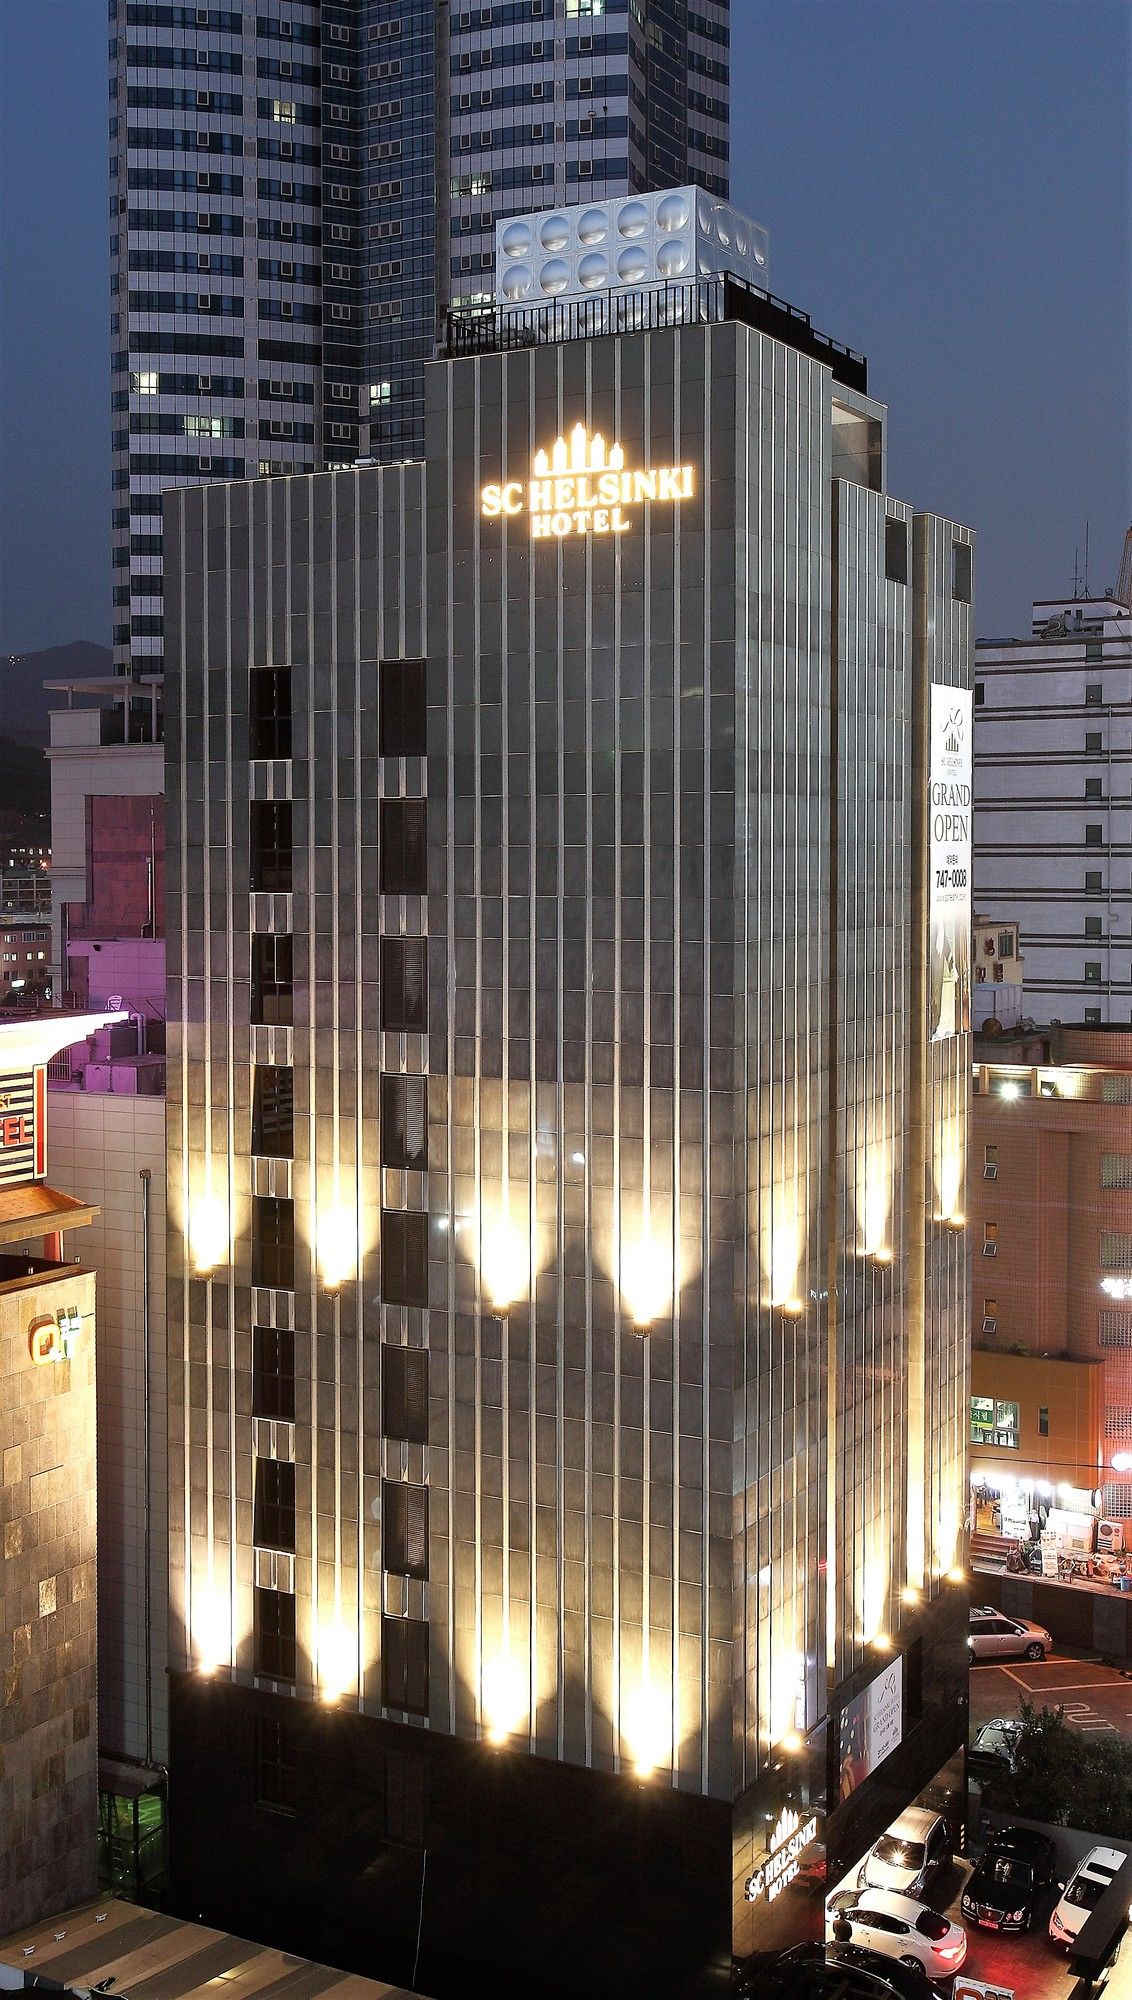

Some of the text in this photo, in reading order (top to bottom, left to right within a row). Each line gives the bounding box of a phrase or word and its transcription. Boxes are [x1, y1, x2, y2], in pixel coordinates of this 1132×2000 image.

[481, 466, 694, 516] SC HELSINKI
[531, 508, 630, 538] HOTEL
[932, 782, 971, 807] GRAND
[934, 813, 968, 842] OPEN
[0, 1116, 33, 1146] EL
